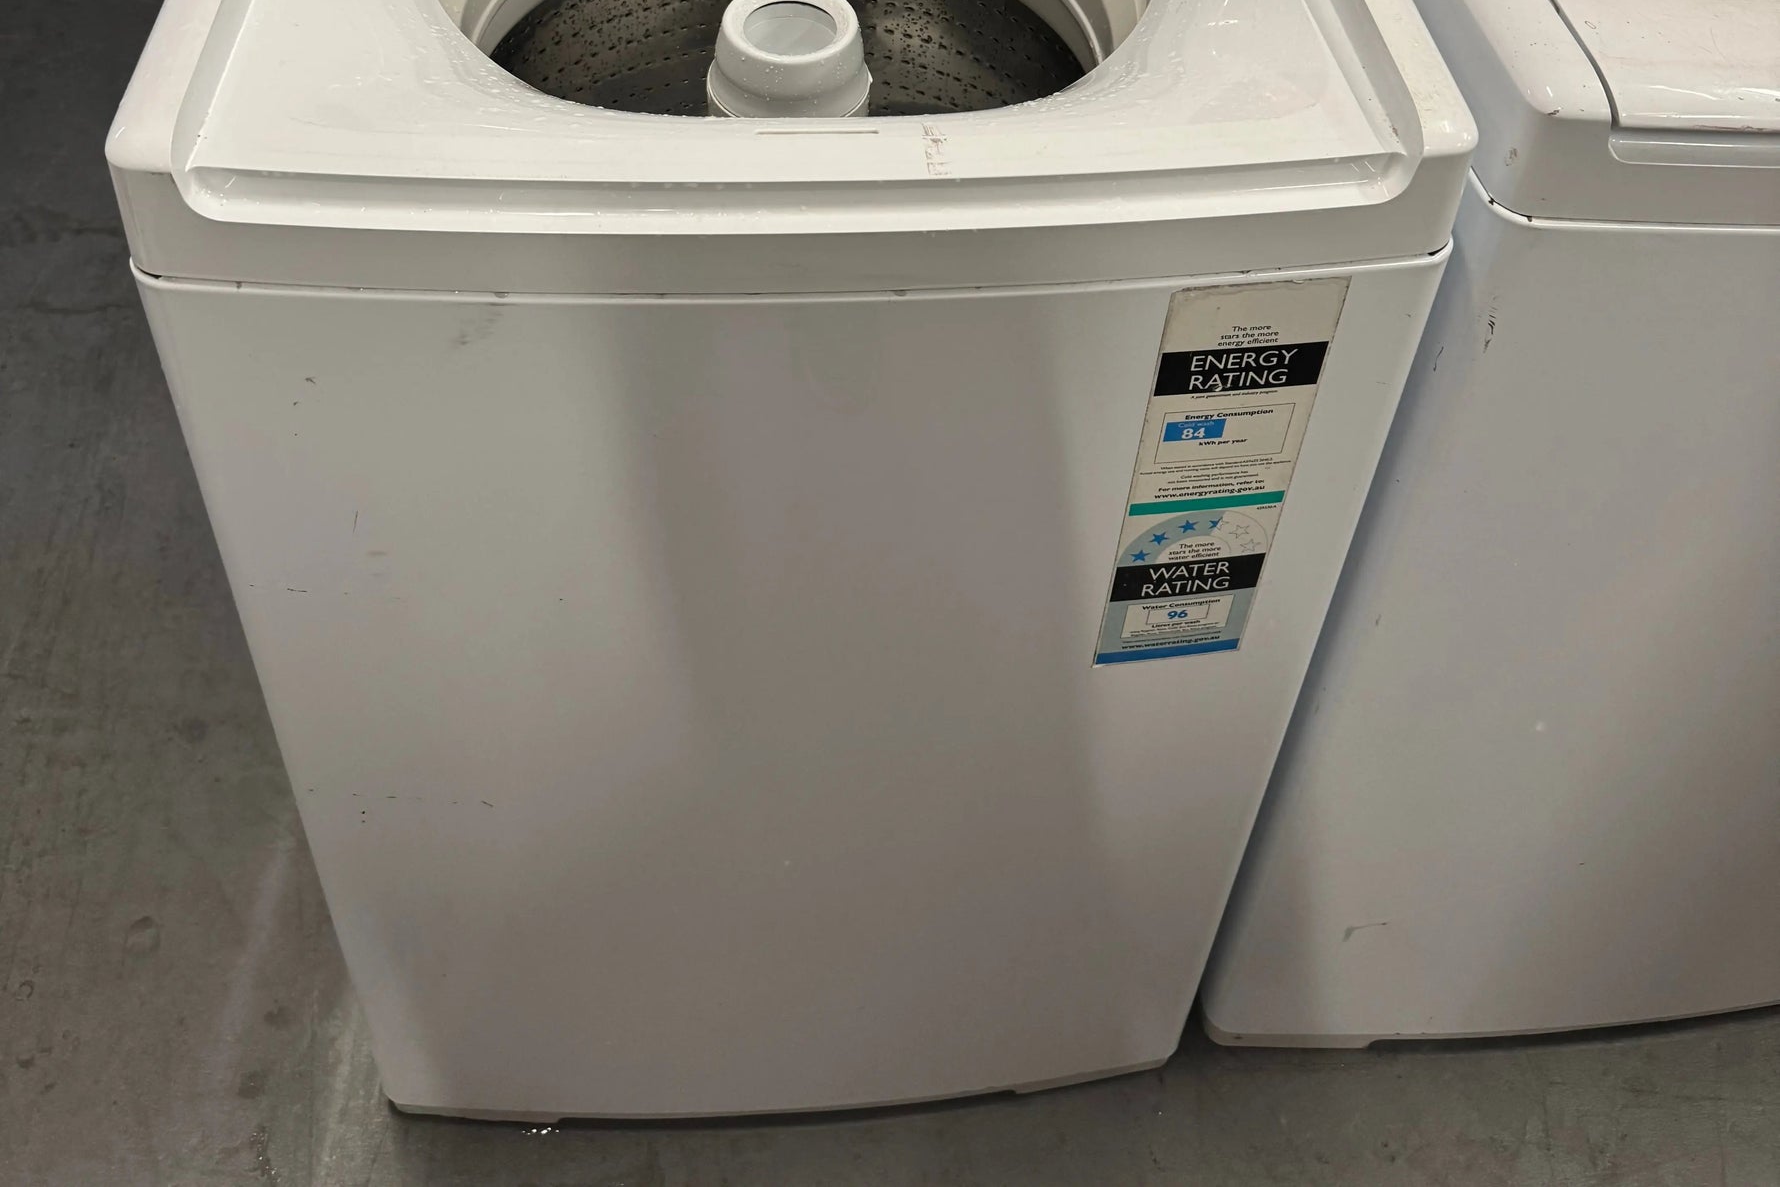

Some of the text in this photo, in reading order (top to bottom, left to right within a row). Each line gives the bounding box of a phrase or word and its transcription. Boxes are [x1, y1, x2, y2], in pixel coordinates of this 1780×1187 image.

[1218, 339, 1245, 347] energy
[1190, 348, 1298, 372] ENERGY
[1189, 369, 1289, 390] RATING
[1185, 409, 1274, 421] Energy Consumption
[1181, 427, 1206, 440] 84
[1154, 485, 1265, 499] www.energyrating.gov.au
[1192, 482, 1235, 490] information,
[1150, 562, 1230, 580] WATER
[1141, 576, 1230, 597] RATING
[1169, 599, 1220, 608] Consumption
[1167, 610, 1188, 619] 96
